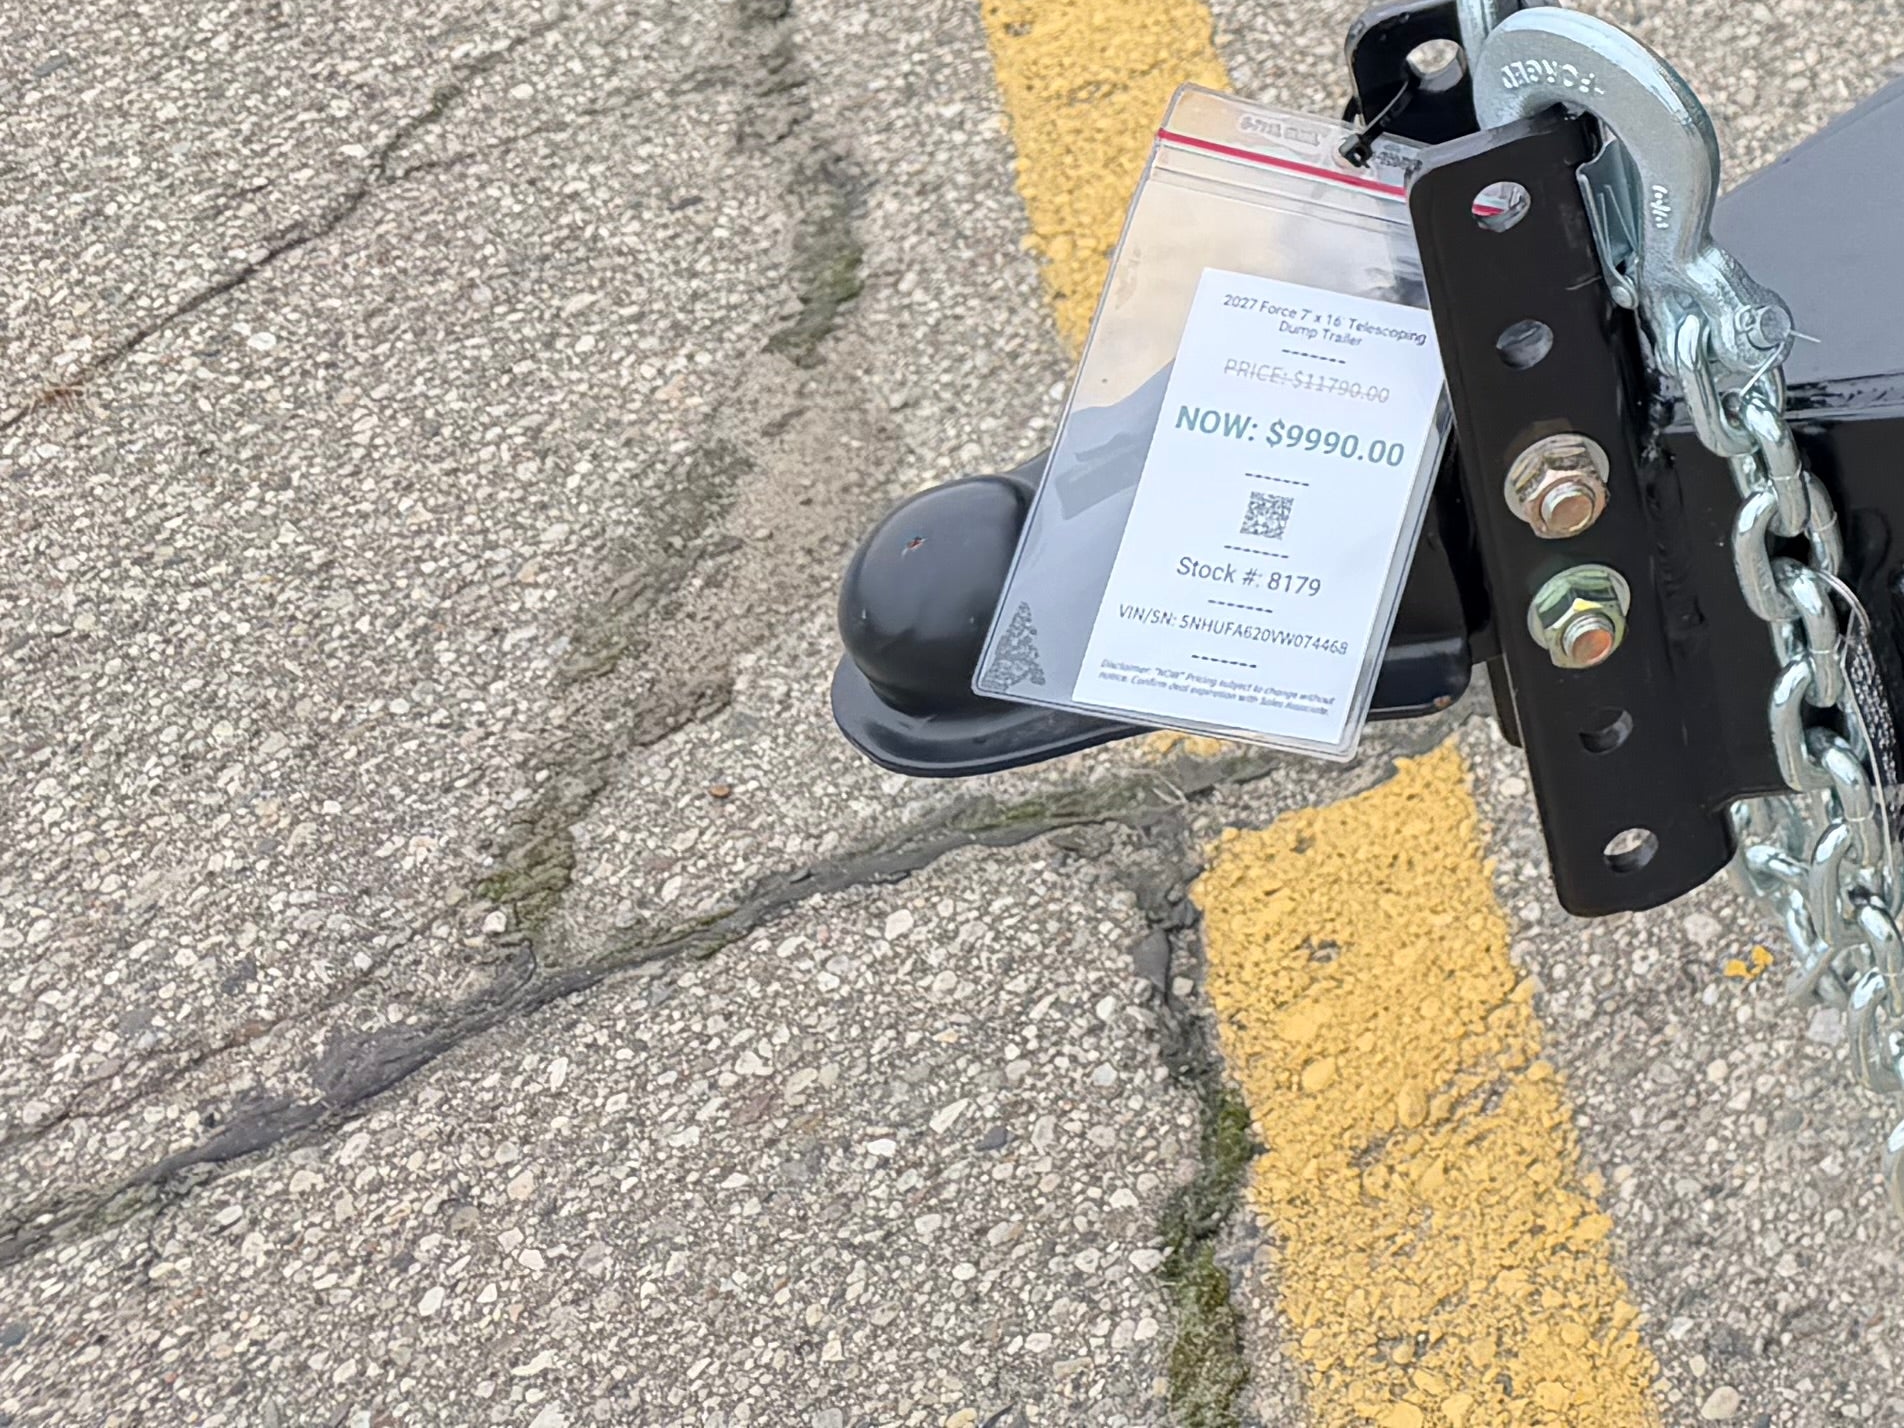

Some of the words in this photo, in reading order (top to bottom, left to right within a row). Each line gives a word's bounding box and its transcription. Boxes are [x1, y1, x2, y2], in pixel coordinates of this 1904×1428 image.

[1221, 293, 1258, 311] 2027
[1258, 300, 1298, 319] Force
[1347, 318, 1427, 346] Telescoping
[1277, 320, 1319, 340] Dump
[1320, 327, 1363, 346] Trailer
[1222, 357, 1289, 385] PRICE:
[1290, 369, 1391, 404] $11790.00
[1174, 404, 1259, 442] NOW:
[1263, 416, 1406, 469] $9990.00
[1175, 555, 1238, 584] Stock
[1266, 570, 1322, 598] 8179
[1116, 603, 1177, 628] VIN/SN:
